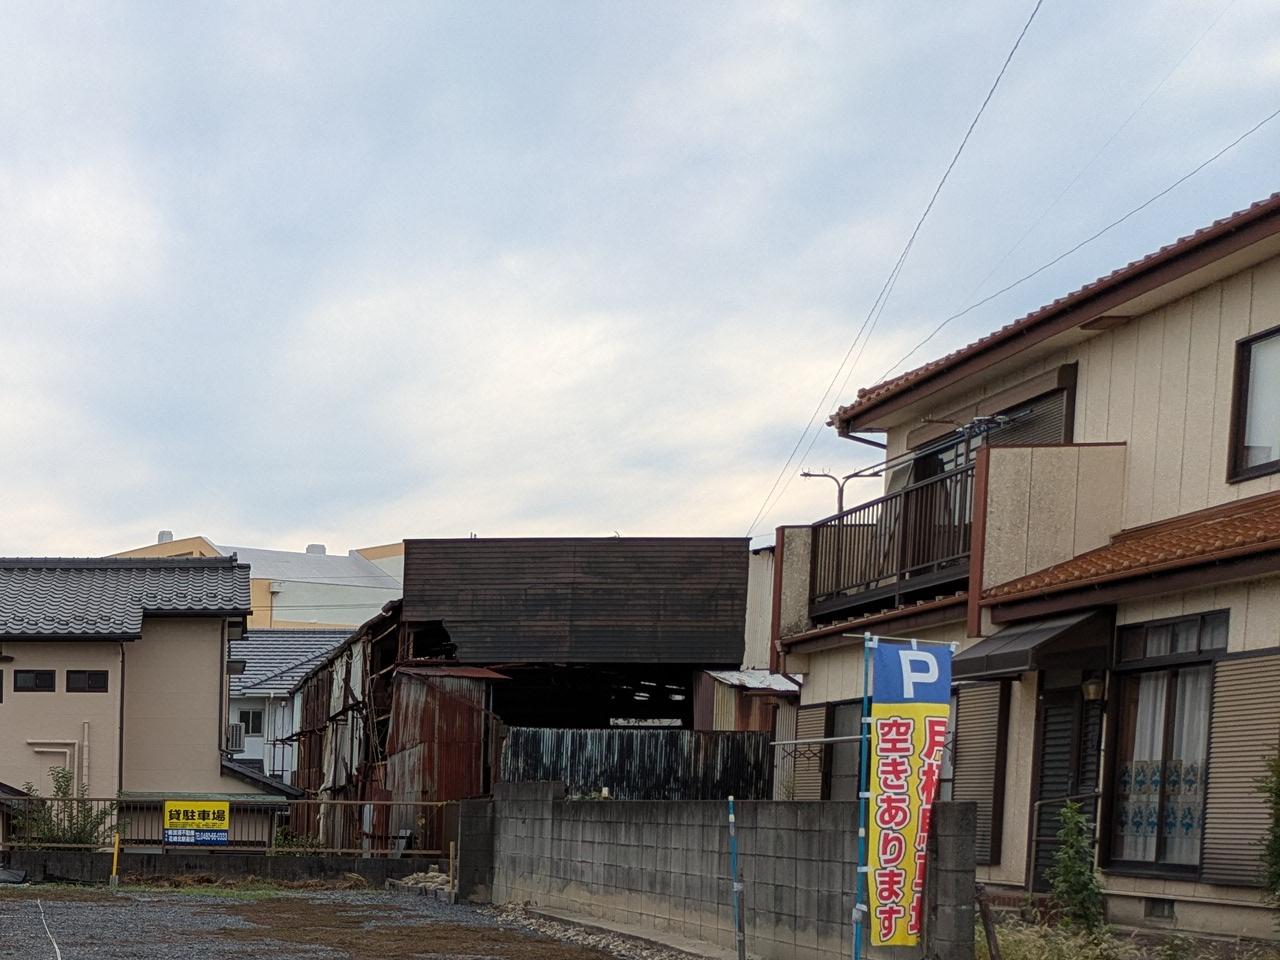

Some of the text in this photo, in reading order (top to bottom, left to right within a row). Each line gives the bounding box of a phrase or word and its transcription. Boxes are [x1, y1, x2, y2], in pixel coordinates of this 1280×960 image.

[898, 650, 939, 698] P
[168, 809, 226, 822] 貸駐車場
[875, 718, 914, 942] 空きあります
